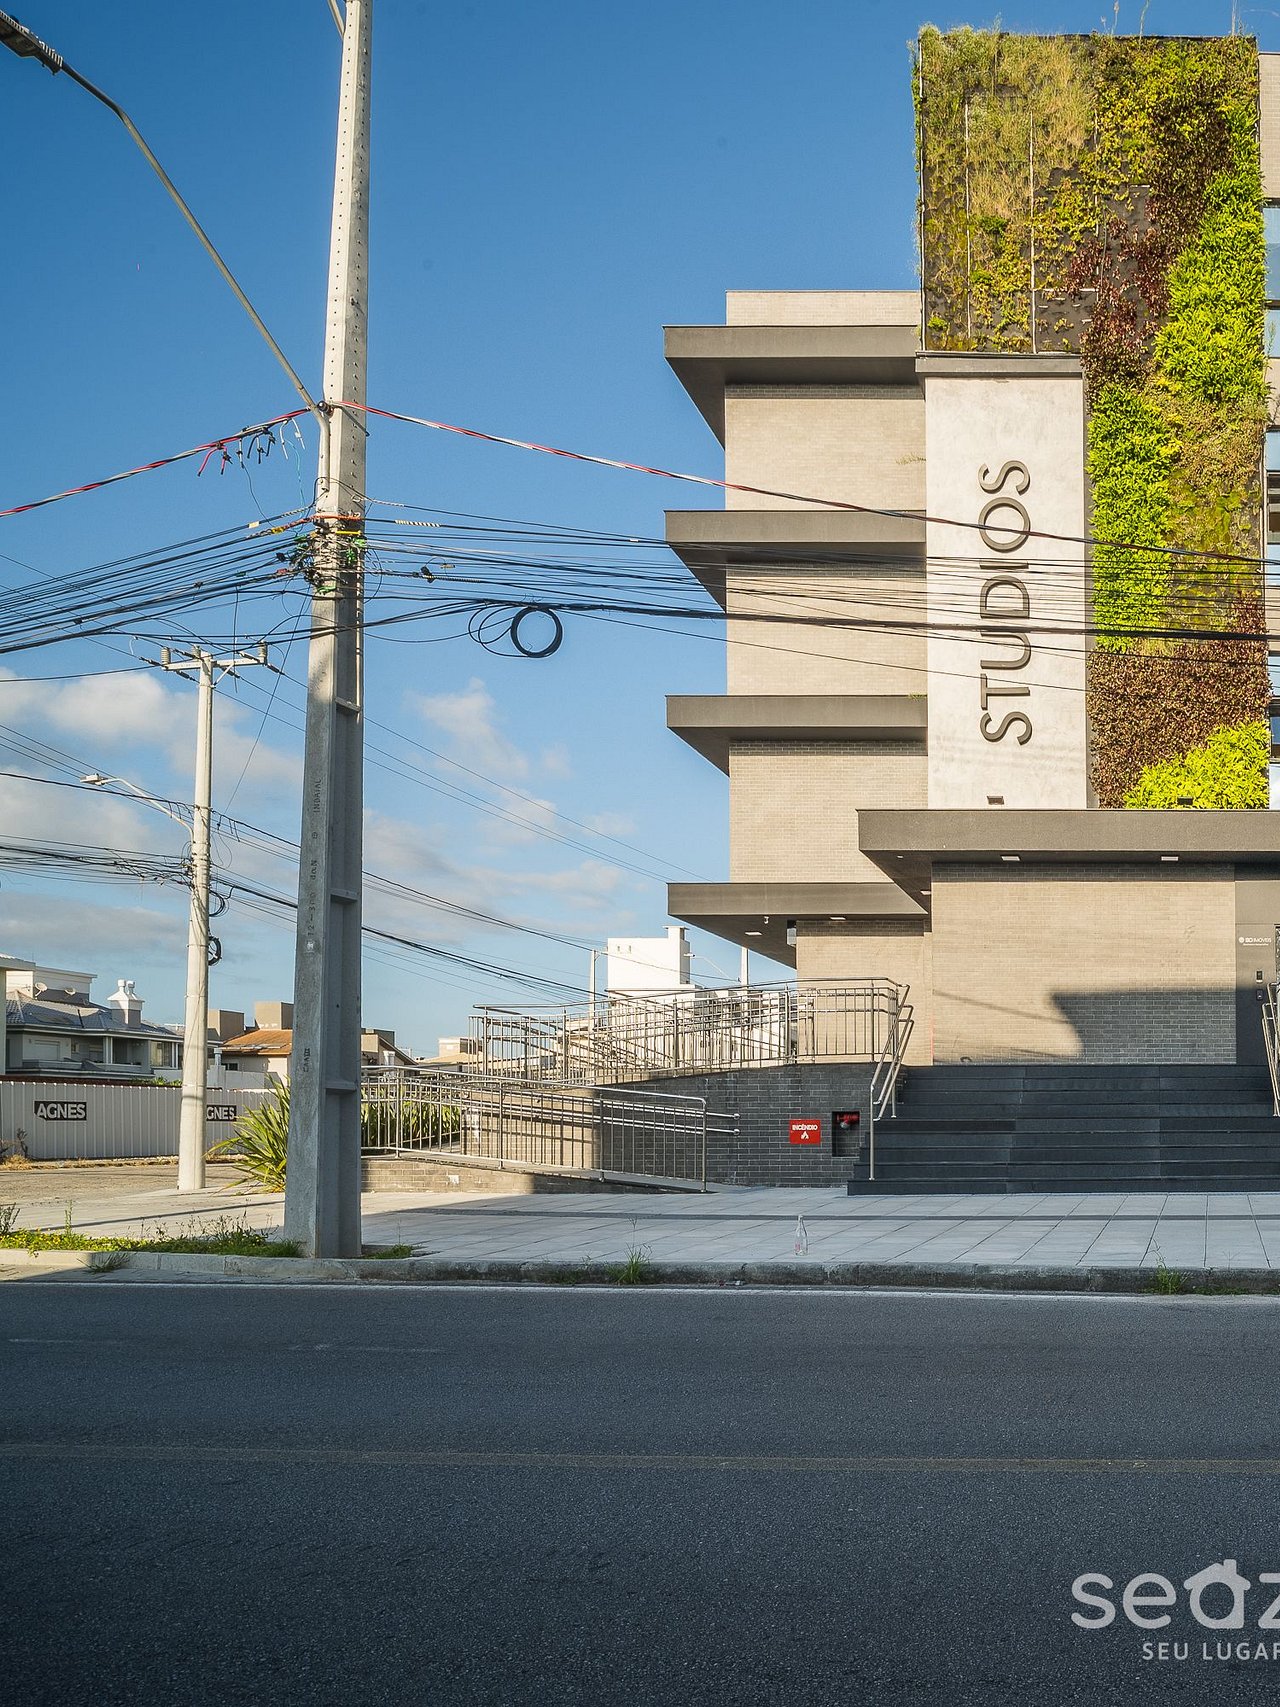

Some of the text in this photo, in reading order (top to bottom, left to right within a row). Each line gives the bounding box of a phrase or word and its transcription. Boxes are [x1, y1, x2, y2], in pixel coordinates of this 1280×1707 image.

[978, 460, 1032, 746] STUDIOS
[36, 1103, 86, 1119] AGNES
[205, 1106, 235, 1120] GNES
[791, 1123, 819, 1131] INCÊNDIO
